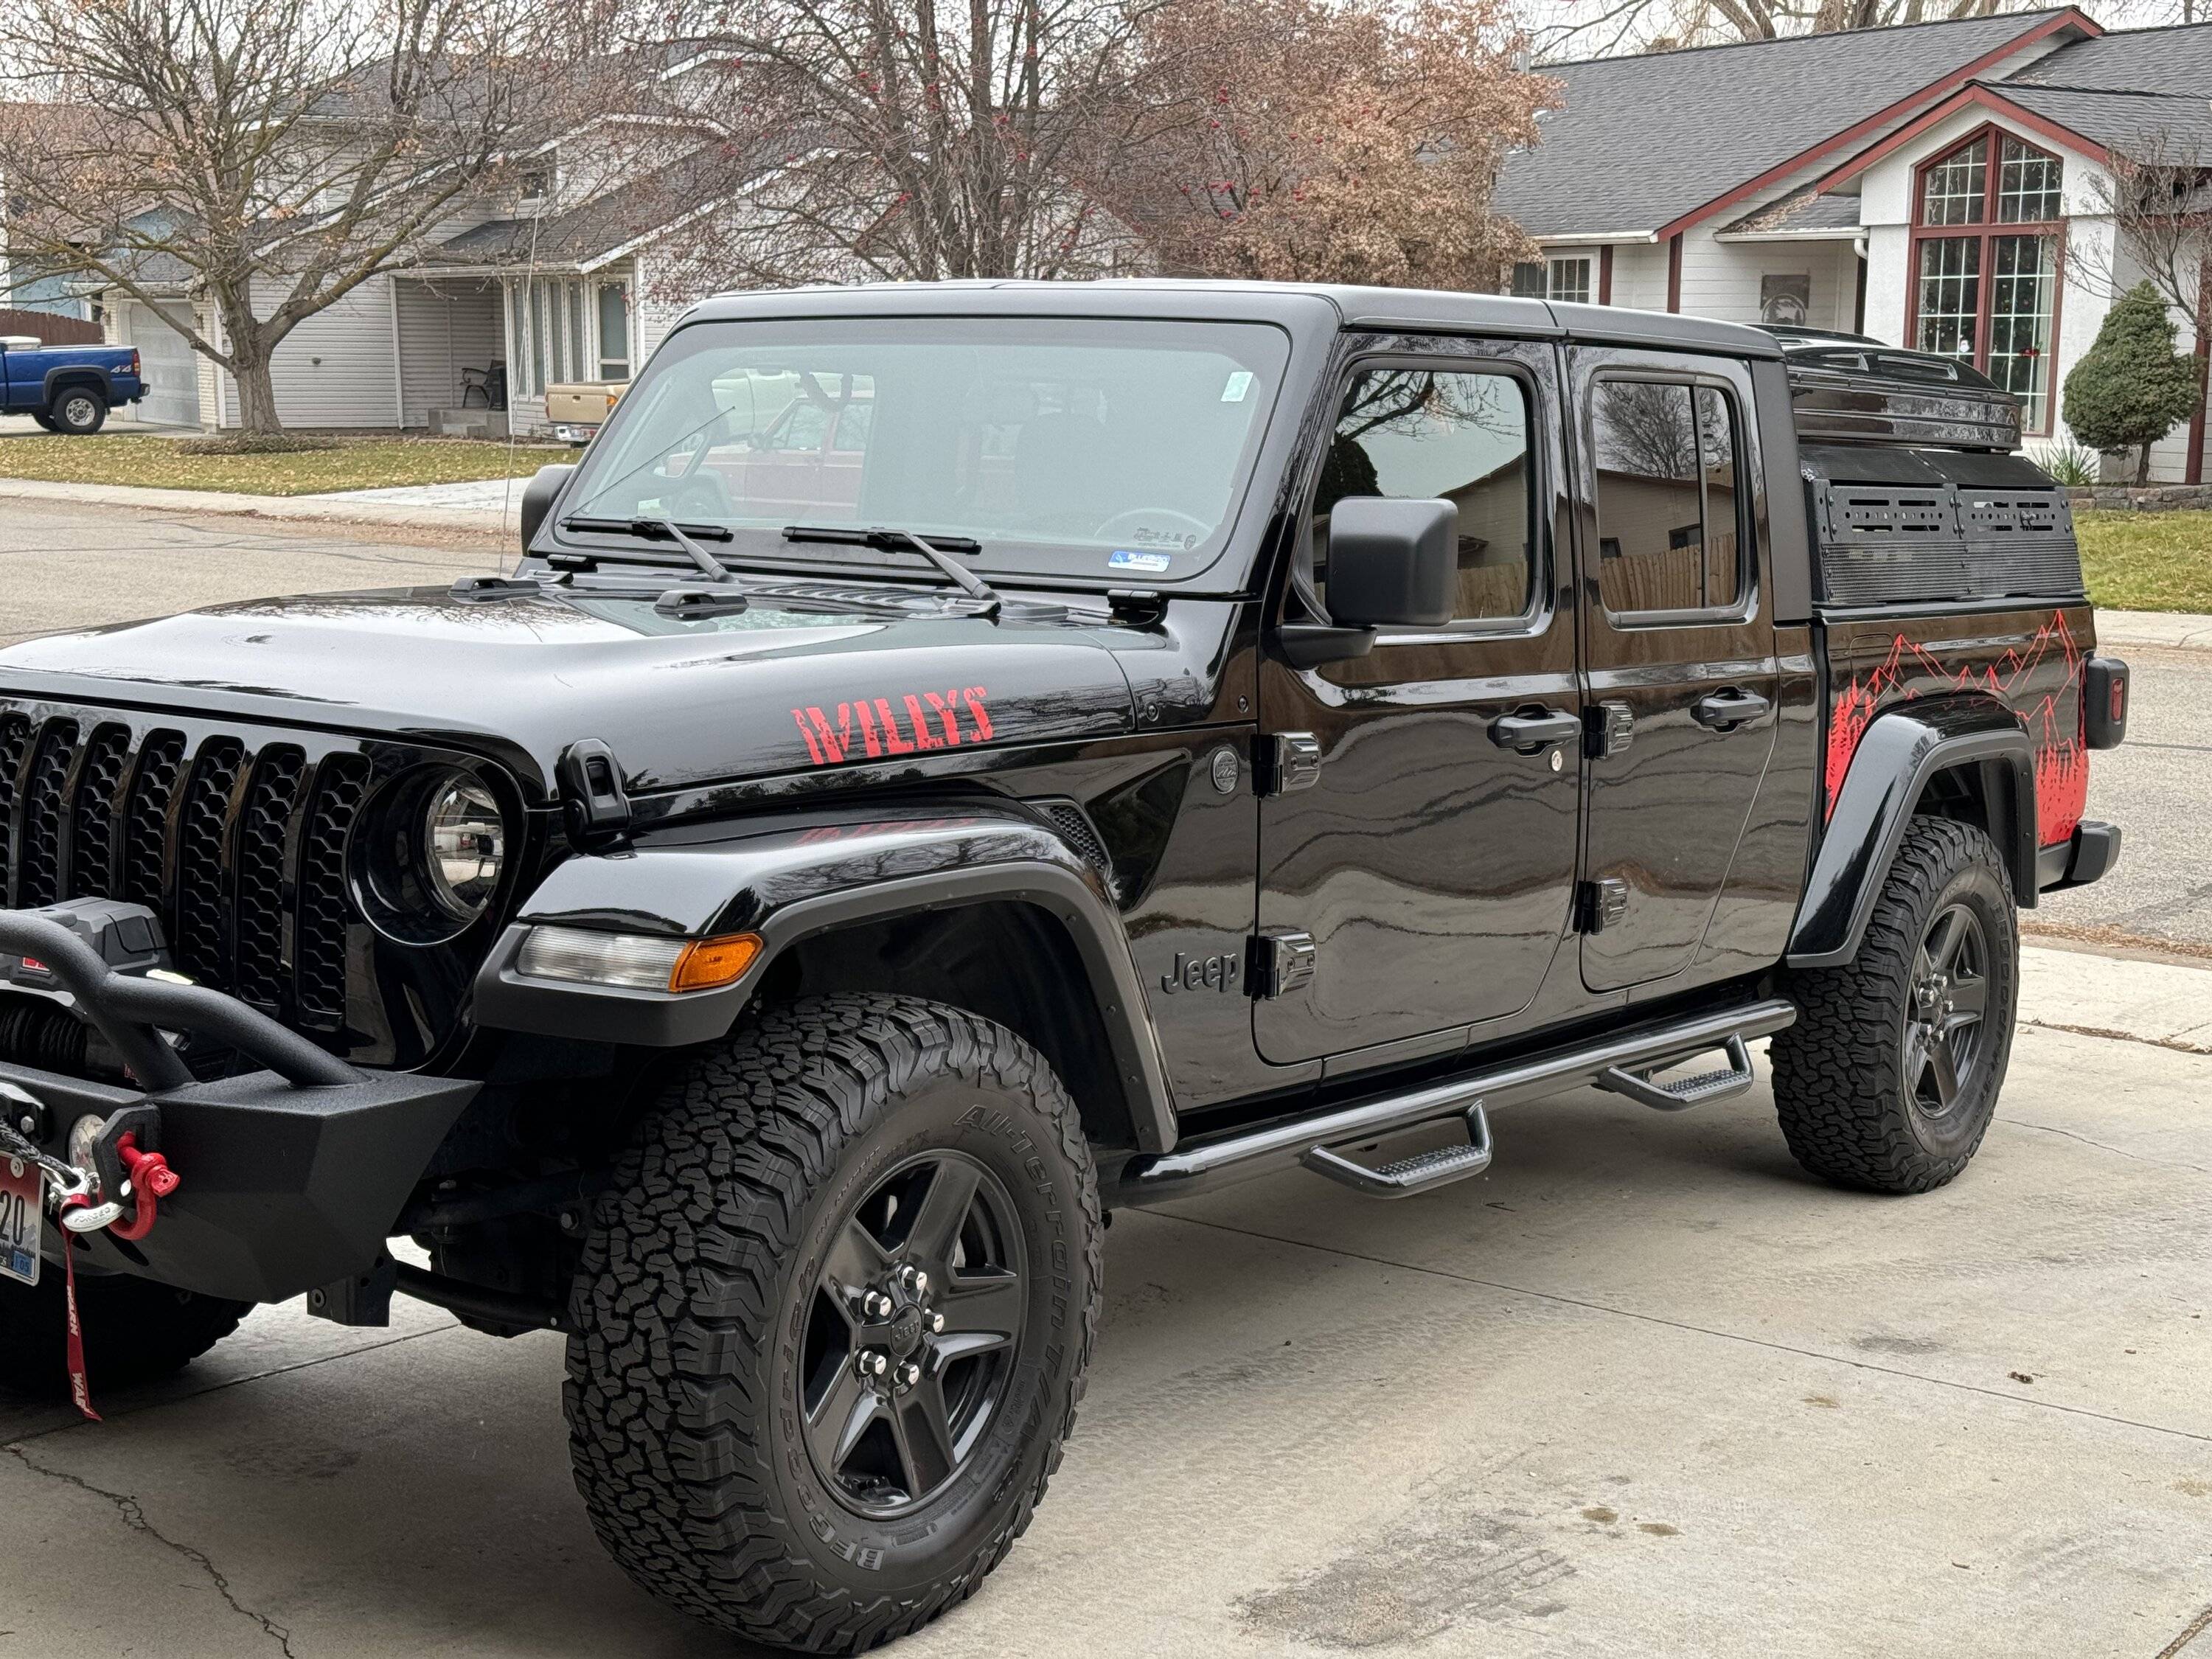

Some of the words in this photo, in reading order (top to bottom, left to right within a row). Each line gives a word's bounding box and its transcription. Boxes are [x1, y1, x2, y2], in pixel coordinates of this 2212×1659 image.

[790, 686, 994, 765] WILLYS
[1161, 952, 1241, 995] Jeep
[952, 1105, 1072, 1330] All-Terrain
[1020, 1344, 1064, 1441] T/A
[894, 1320, 920, 1340] Jeep
[780, 1255, 885, 1572] BFGoodrich
